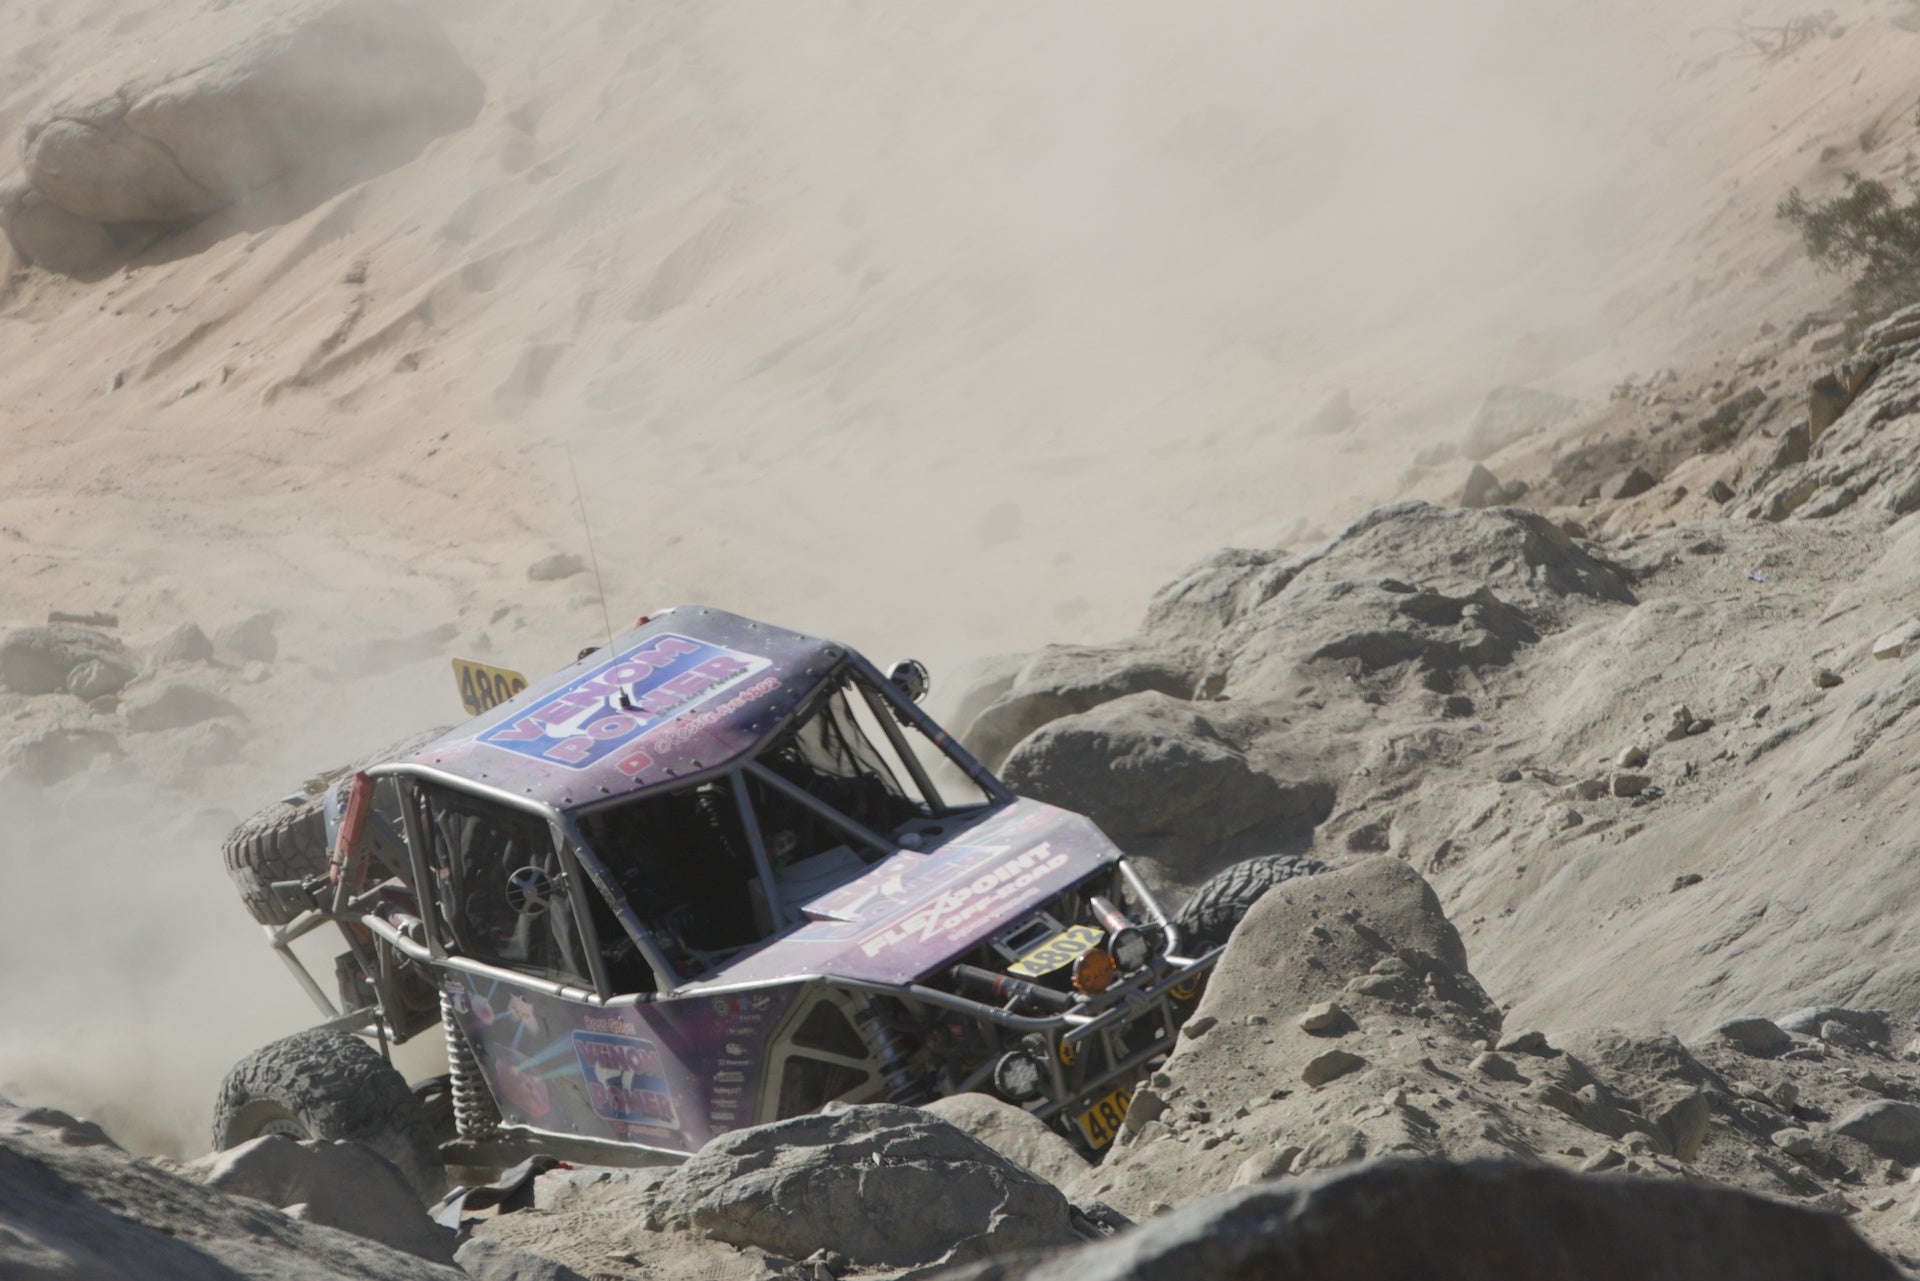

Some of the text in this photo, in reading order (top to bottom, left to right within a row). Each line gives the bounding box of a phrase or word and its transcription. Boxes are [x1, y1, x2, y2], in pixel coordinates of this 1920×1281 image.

[489, 637, 700, 741] VENOM
[543, 655, 754, 763] POWER
[856, 841, 1051, 957] FLEXPOINT
[1023, 928, 1097, 975] 4802
[575, 1039, 664, 1078] VENOM
[588, 1083, 674, 1119] POWER
